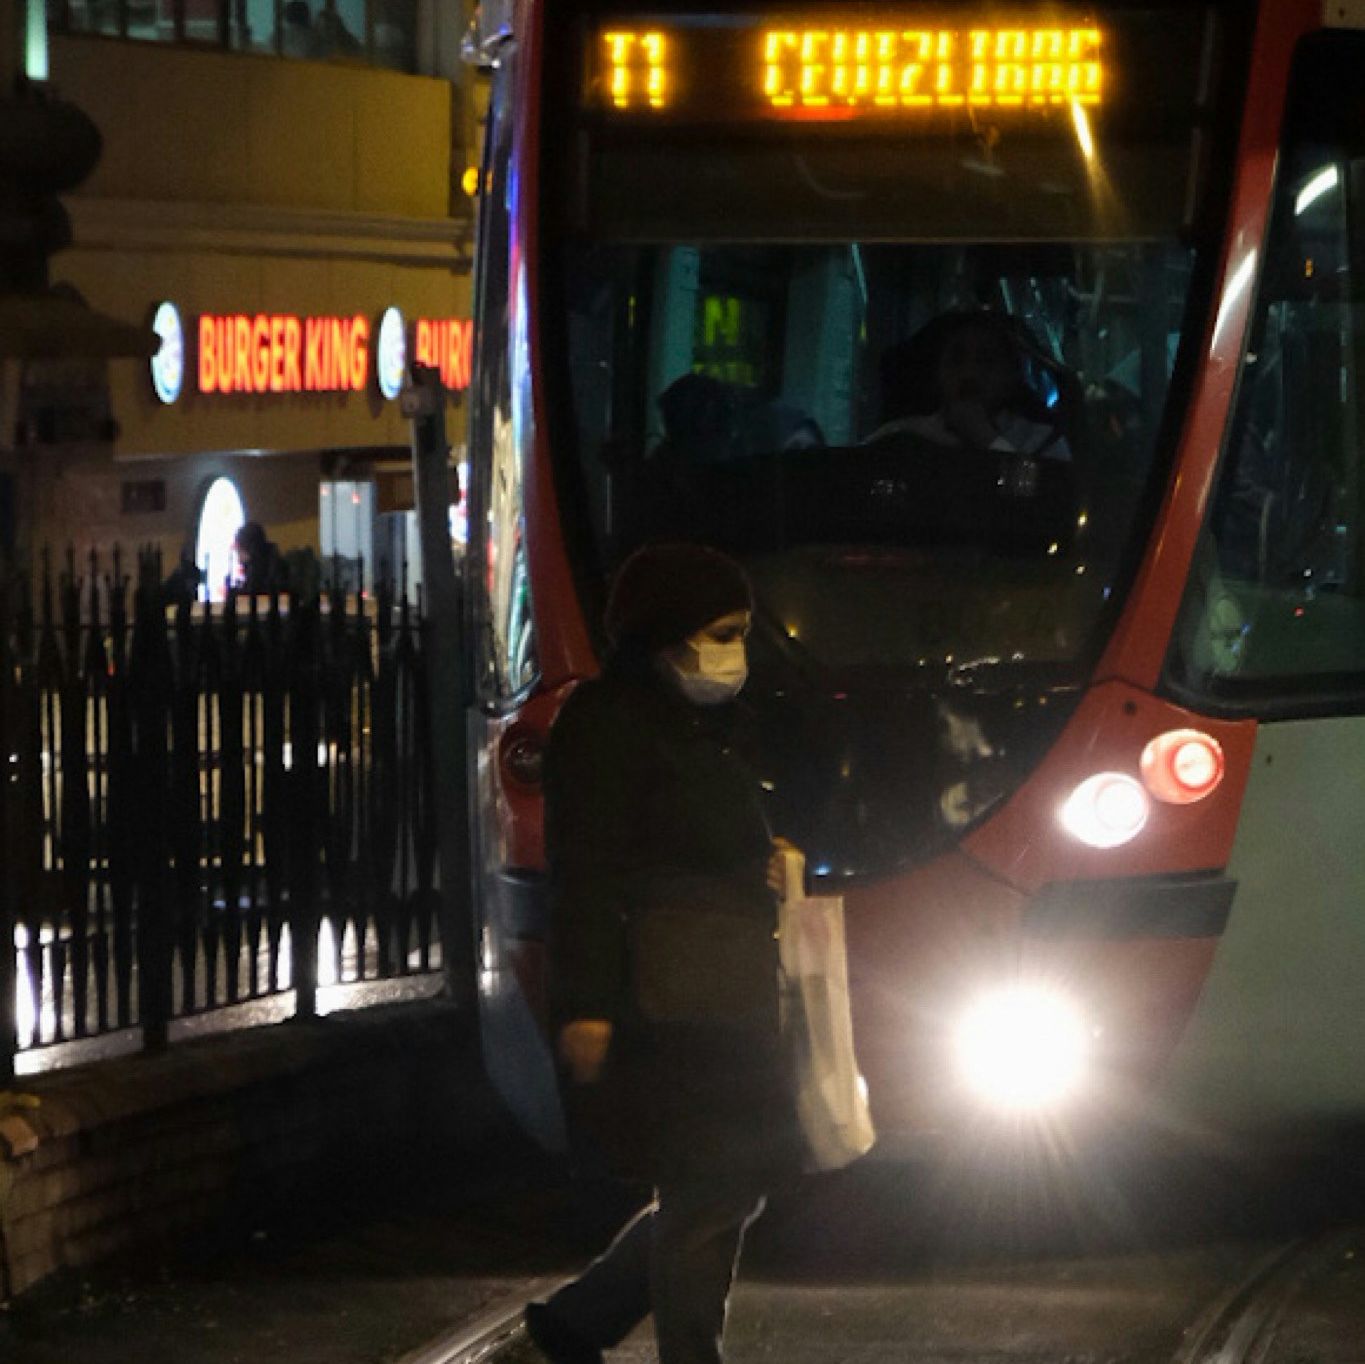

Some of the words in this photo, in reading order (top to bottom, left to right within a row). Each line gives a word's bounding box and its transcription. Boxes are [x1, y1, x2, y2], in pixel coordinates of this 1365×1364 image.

[604, 31, 666, 109] T1
[198, 314, 299, 393] BURGER
[304, 315, 369, 391] KING
